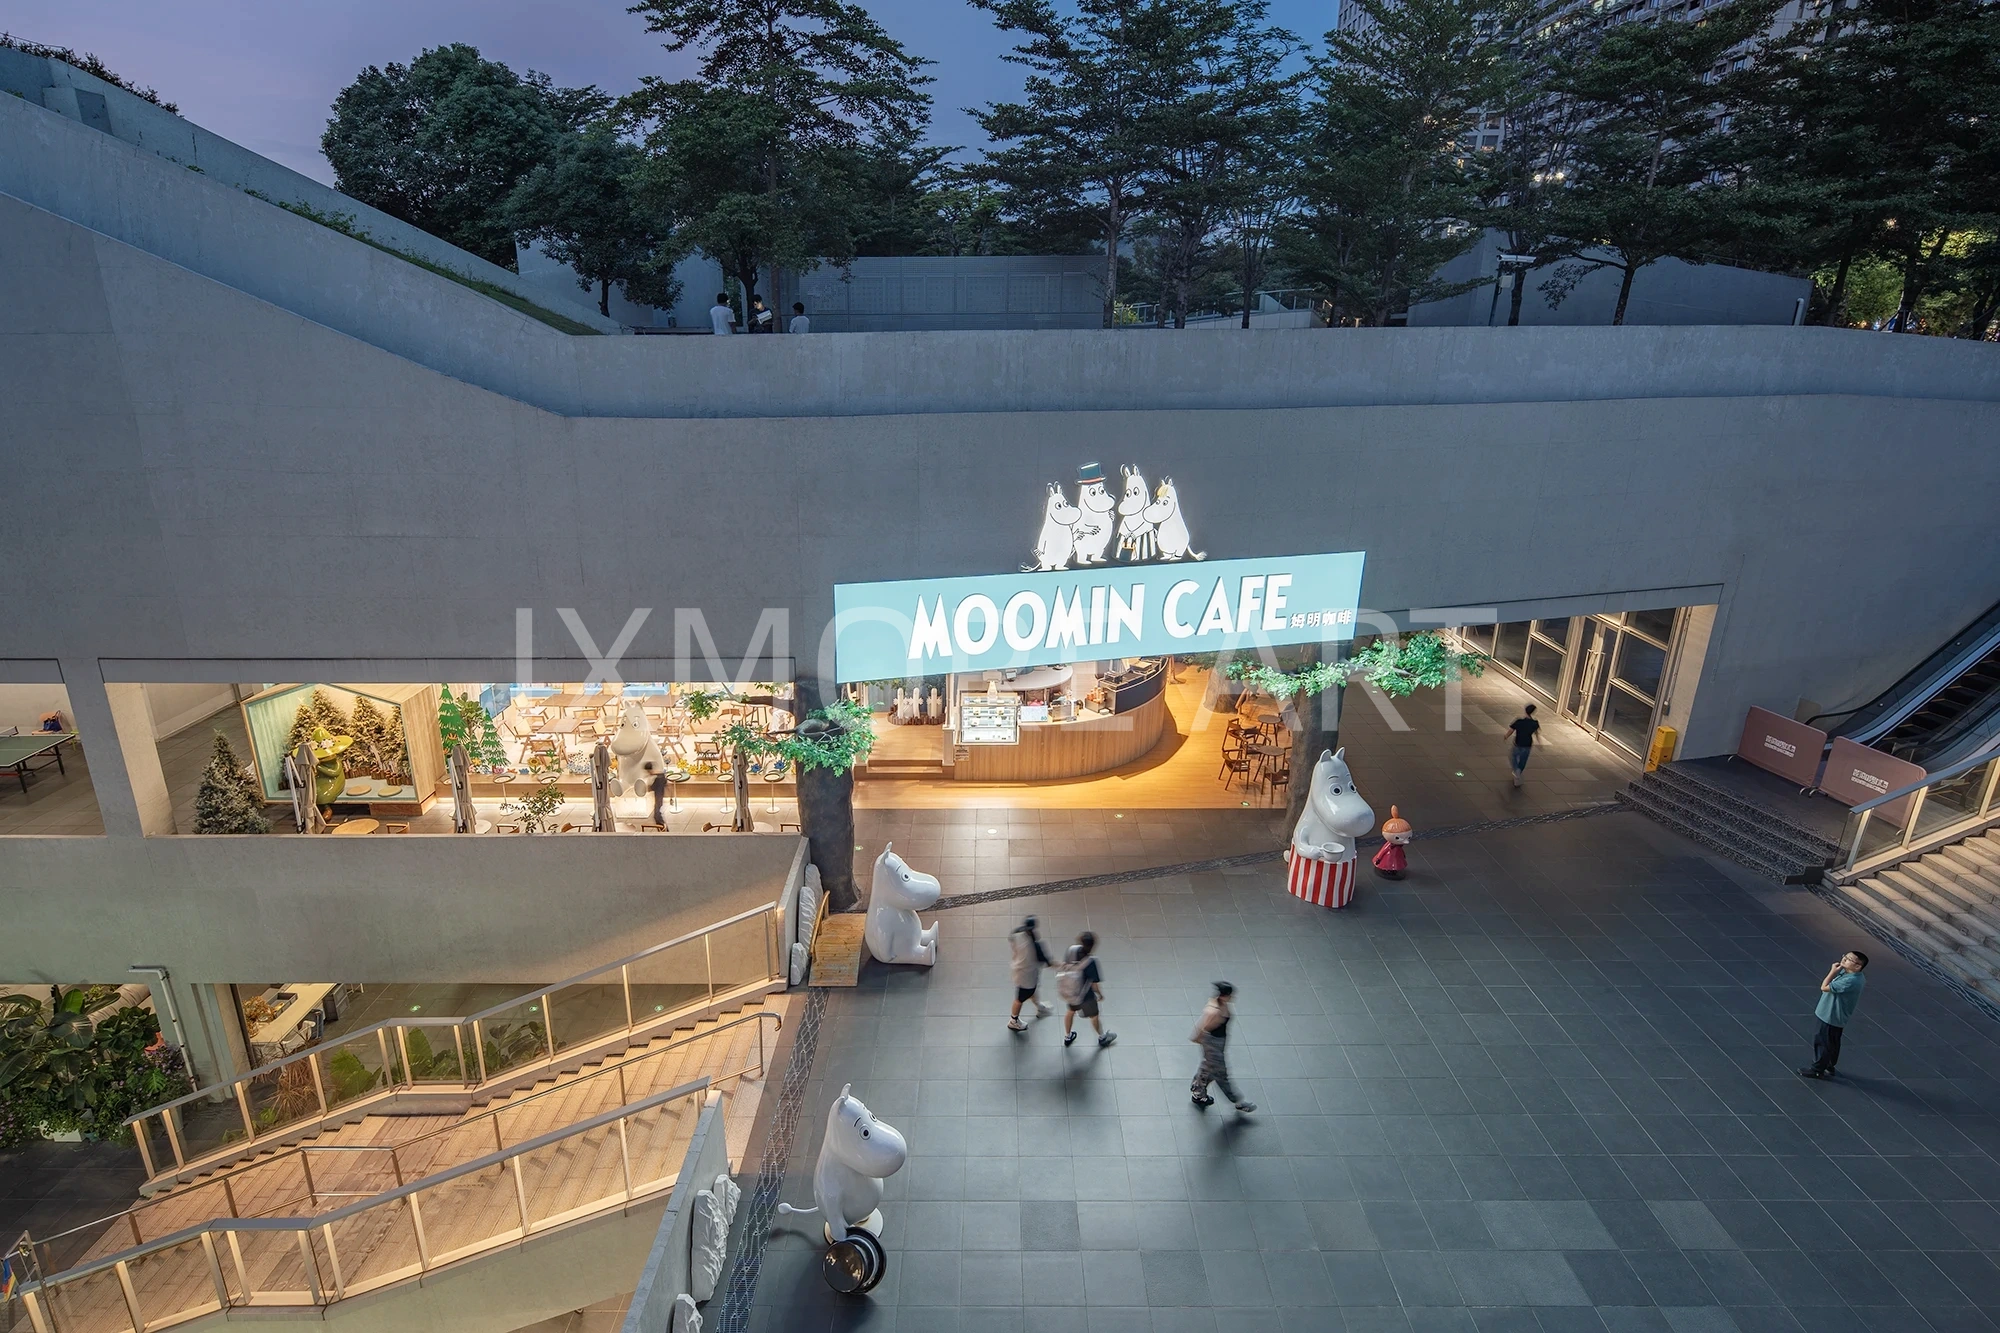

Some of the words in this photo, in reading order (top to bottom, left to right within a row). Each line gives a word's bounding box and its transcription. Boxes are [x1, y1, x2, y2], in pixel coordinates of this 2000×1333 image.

[907, 583, 1146, 660] MOOMIN
[1162, 573, 1293, 639] CAFE
[1290, 609, 1352, 629] 姆明咖啡
